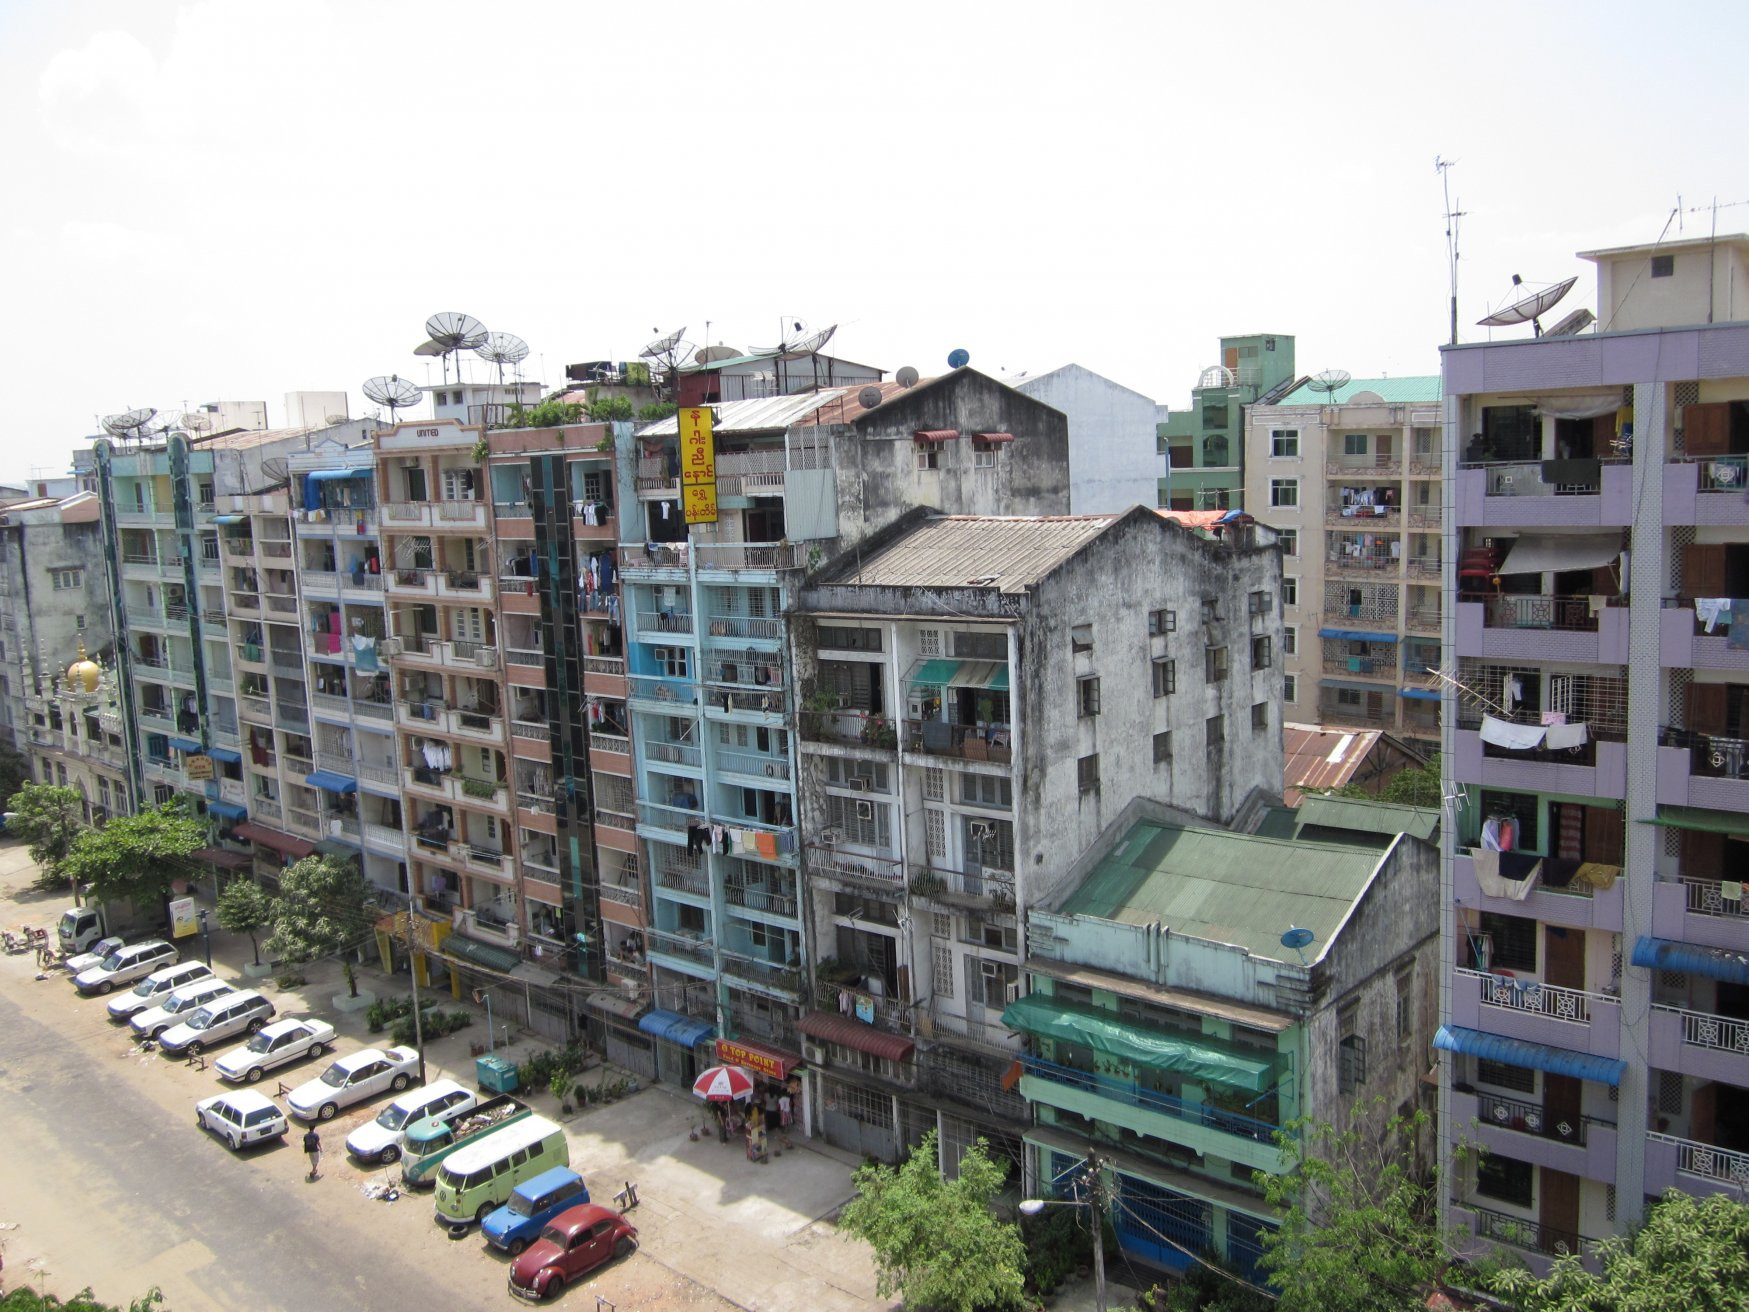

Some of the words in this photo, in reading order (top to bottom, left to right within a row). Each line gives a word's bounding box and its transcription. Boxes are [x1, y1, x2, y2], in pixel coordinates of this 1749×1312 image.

[416, 428, 438, 438] UNITED
[730, 1046, 747, 1058] TOP
[749, 1053, 775, 1069] POINT
